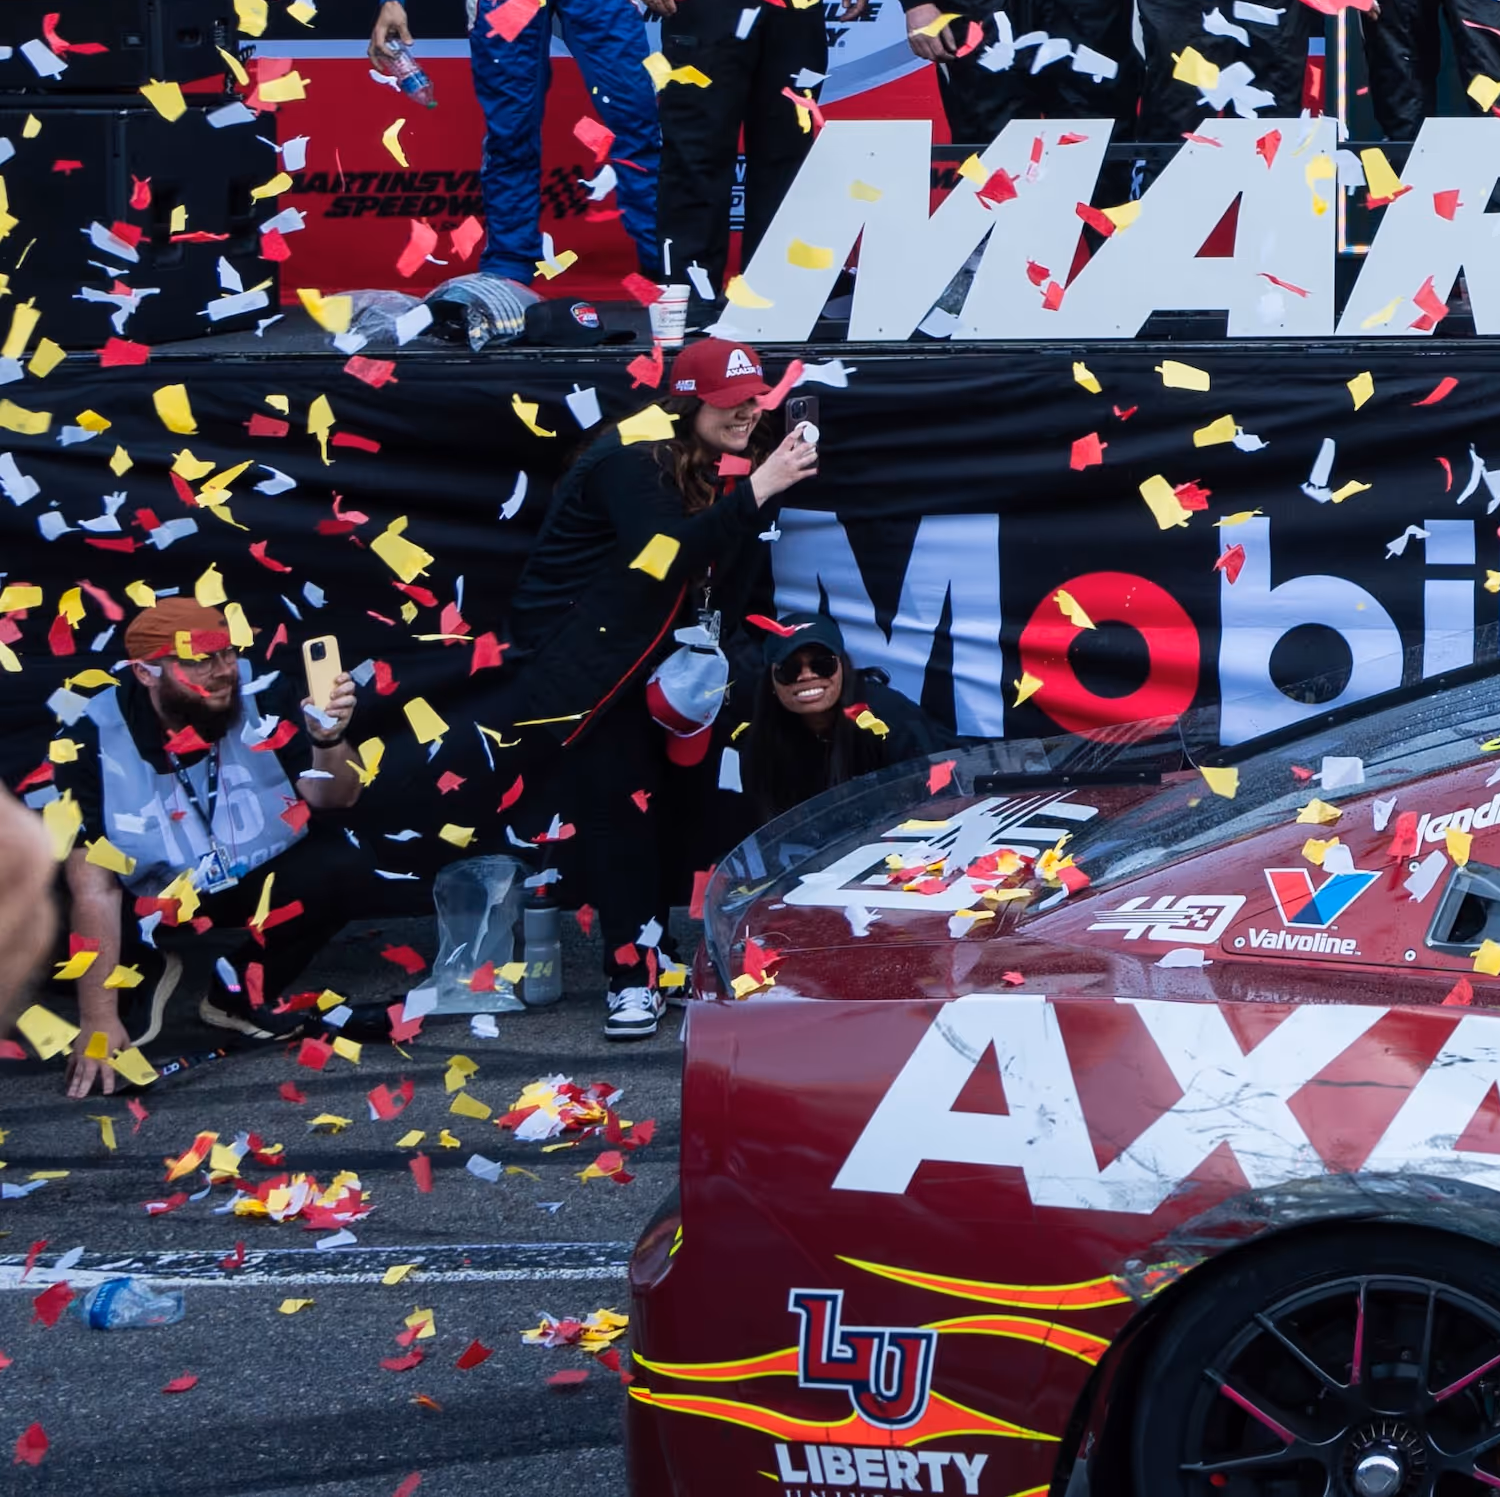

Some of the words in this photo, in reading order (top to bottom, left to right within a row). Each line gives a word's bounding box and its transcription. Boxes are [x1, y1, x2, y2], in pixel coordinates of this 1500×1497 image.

[1249, 928, 1357, 956] Valvoline
[787, 1287, 939, 1431] LU
[774, 1442, 989, 1495] LIBERTY
